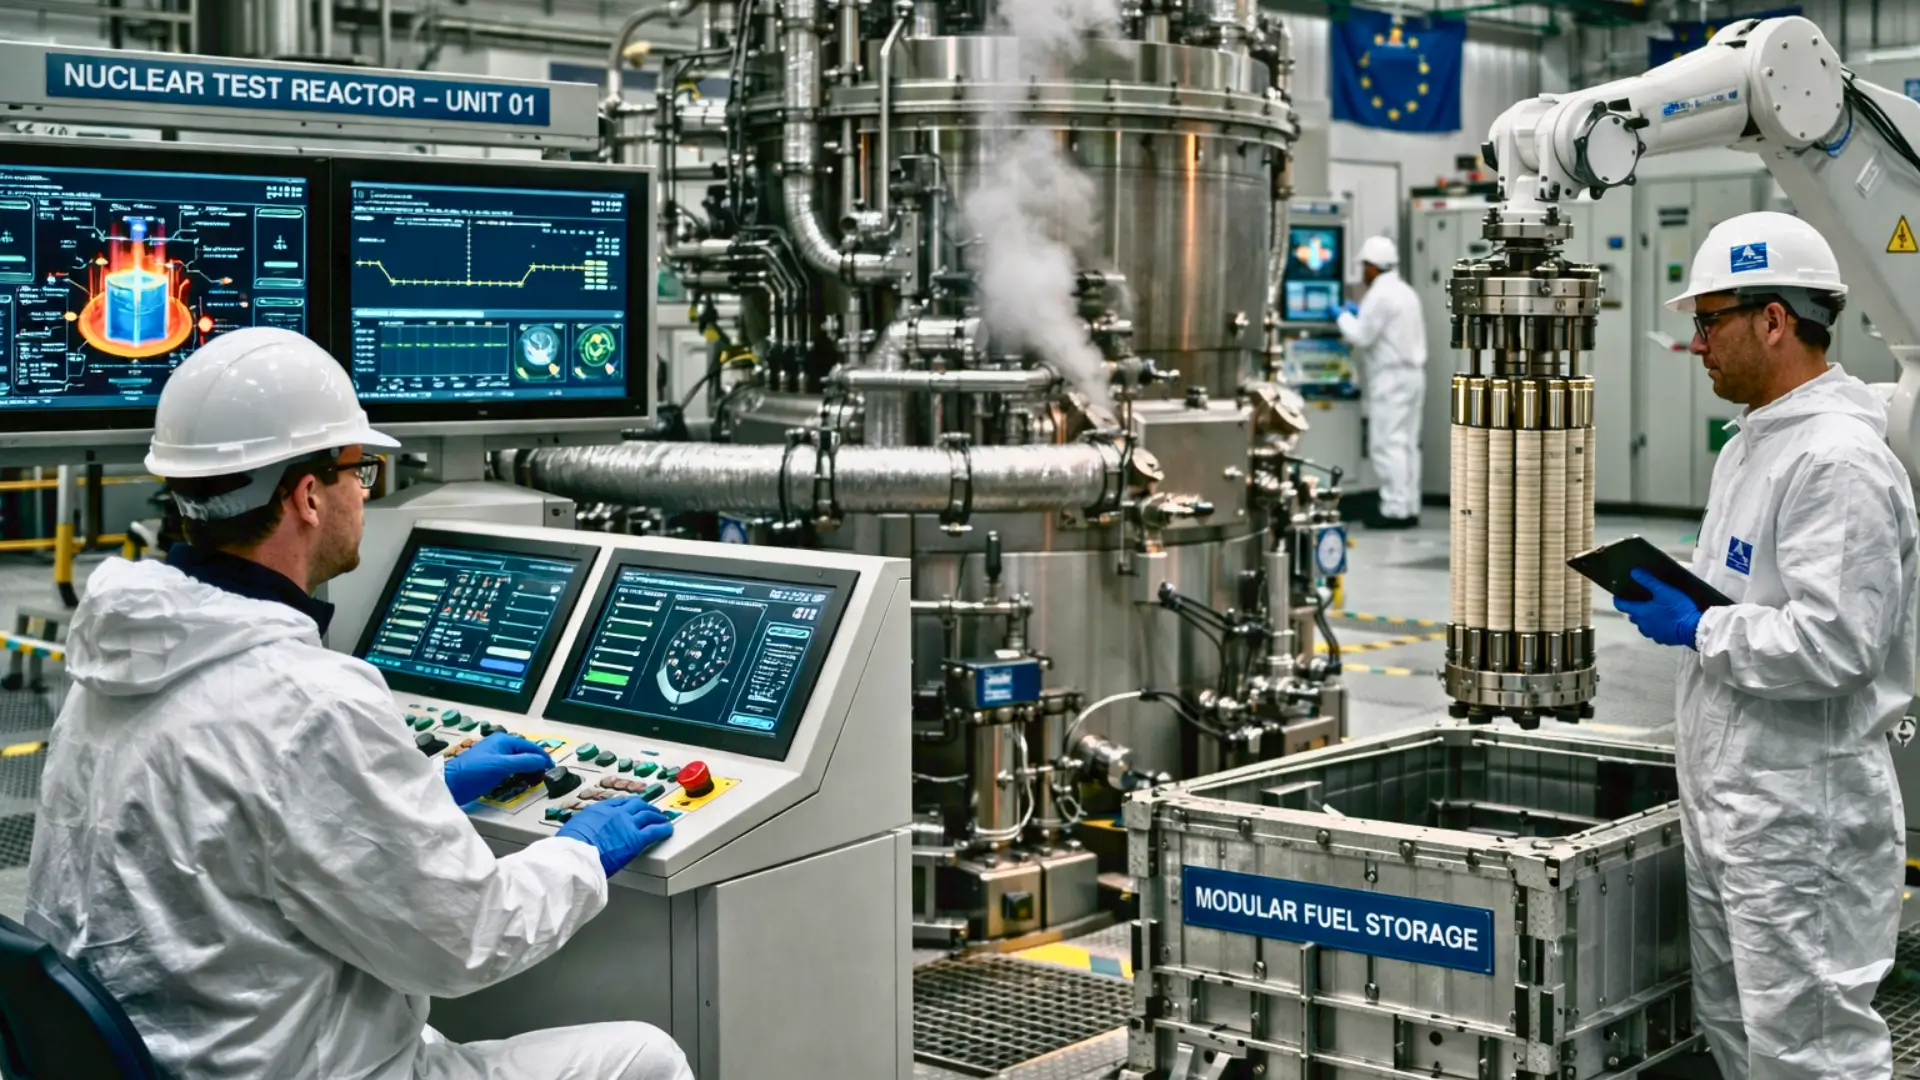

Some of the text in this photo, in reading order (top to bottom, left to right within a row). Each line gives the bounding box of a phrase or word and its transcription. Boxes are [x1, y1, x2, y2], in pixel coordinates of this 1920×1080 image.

[64, 62, 204, 95] NUCLEAR
[212, 72, 283, 100] TEST
[291, 78, 415, 108] REACTOR
[446, 89, 503, 113] UNIT
[508, 93, 534, 116] 01
[1195, 886, 1479, 952] MODULAR FUEL STORAGE
